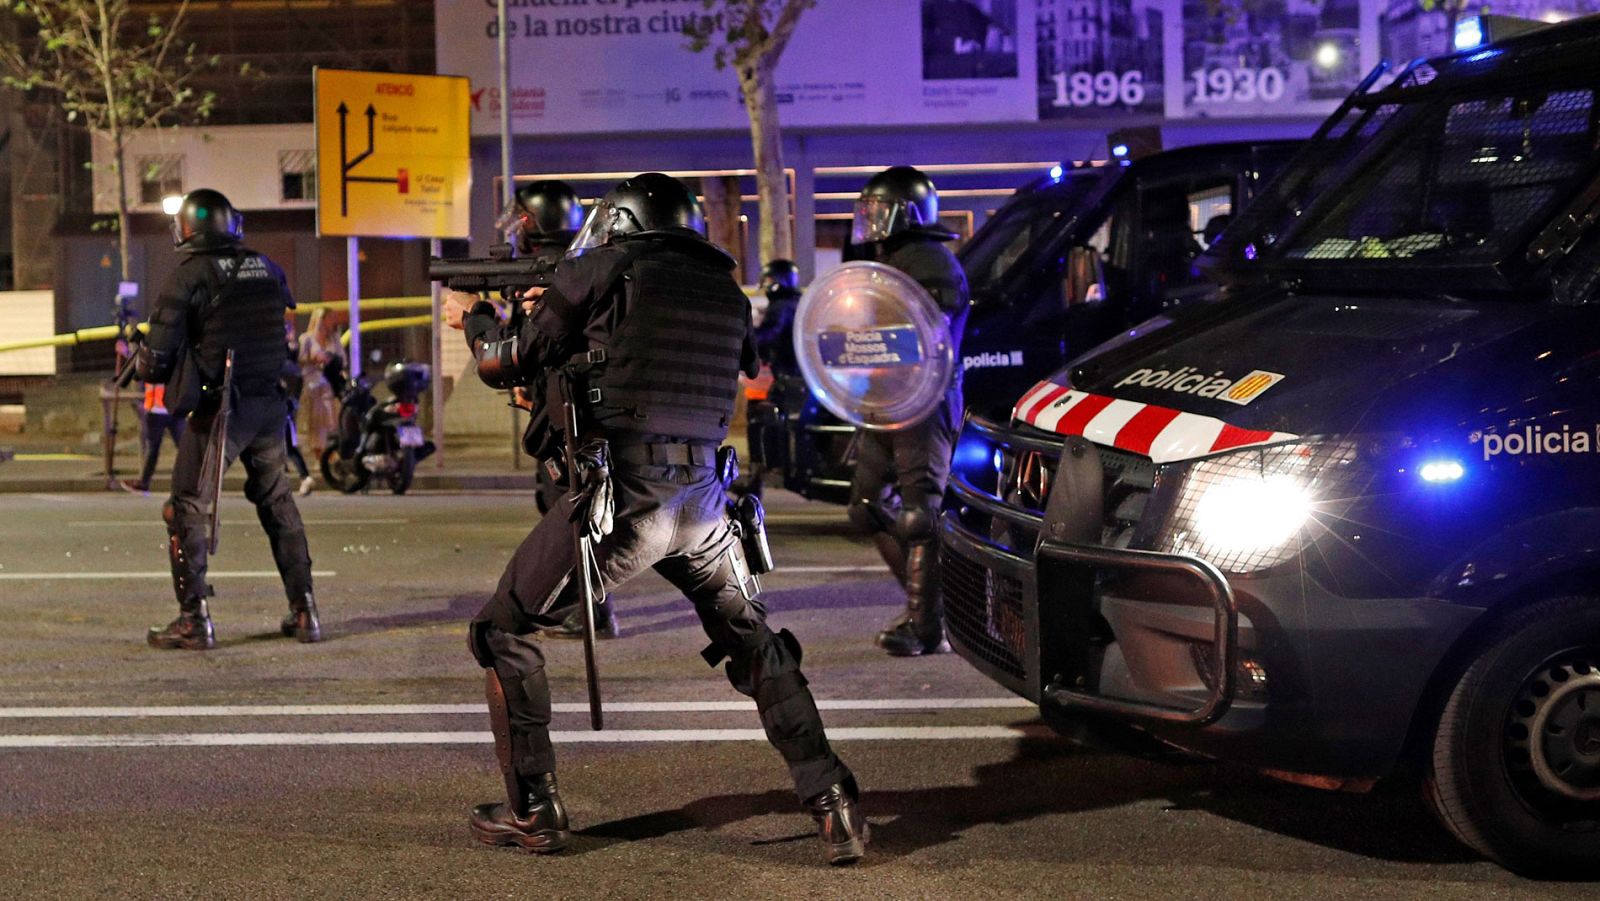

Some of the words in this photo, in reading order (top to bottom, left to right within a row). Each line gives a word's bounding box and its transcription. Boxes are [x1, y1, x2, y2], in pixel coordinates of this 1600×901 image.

[485, 14, 517, 38] de
[524, 14, 548, 37] la
[555, 13, 641, 36] nostra
[1052, 70, 1145, 107] 1896
[1191, 66, 1284, 102] 1930
[218, 257, 266, 271] POICIA
[844, 342, 888, 353] Mossos
[963, 351, 1010, 371] policia
[1113, 366, 1232, 399] policia
[1483, 424, 1590, 461] policia
